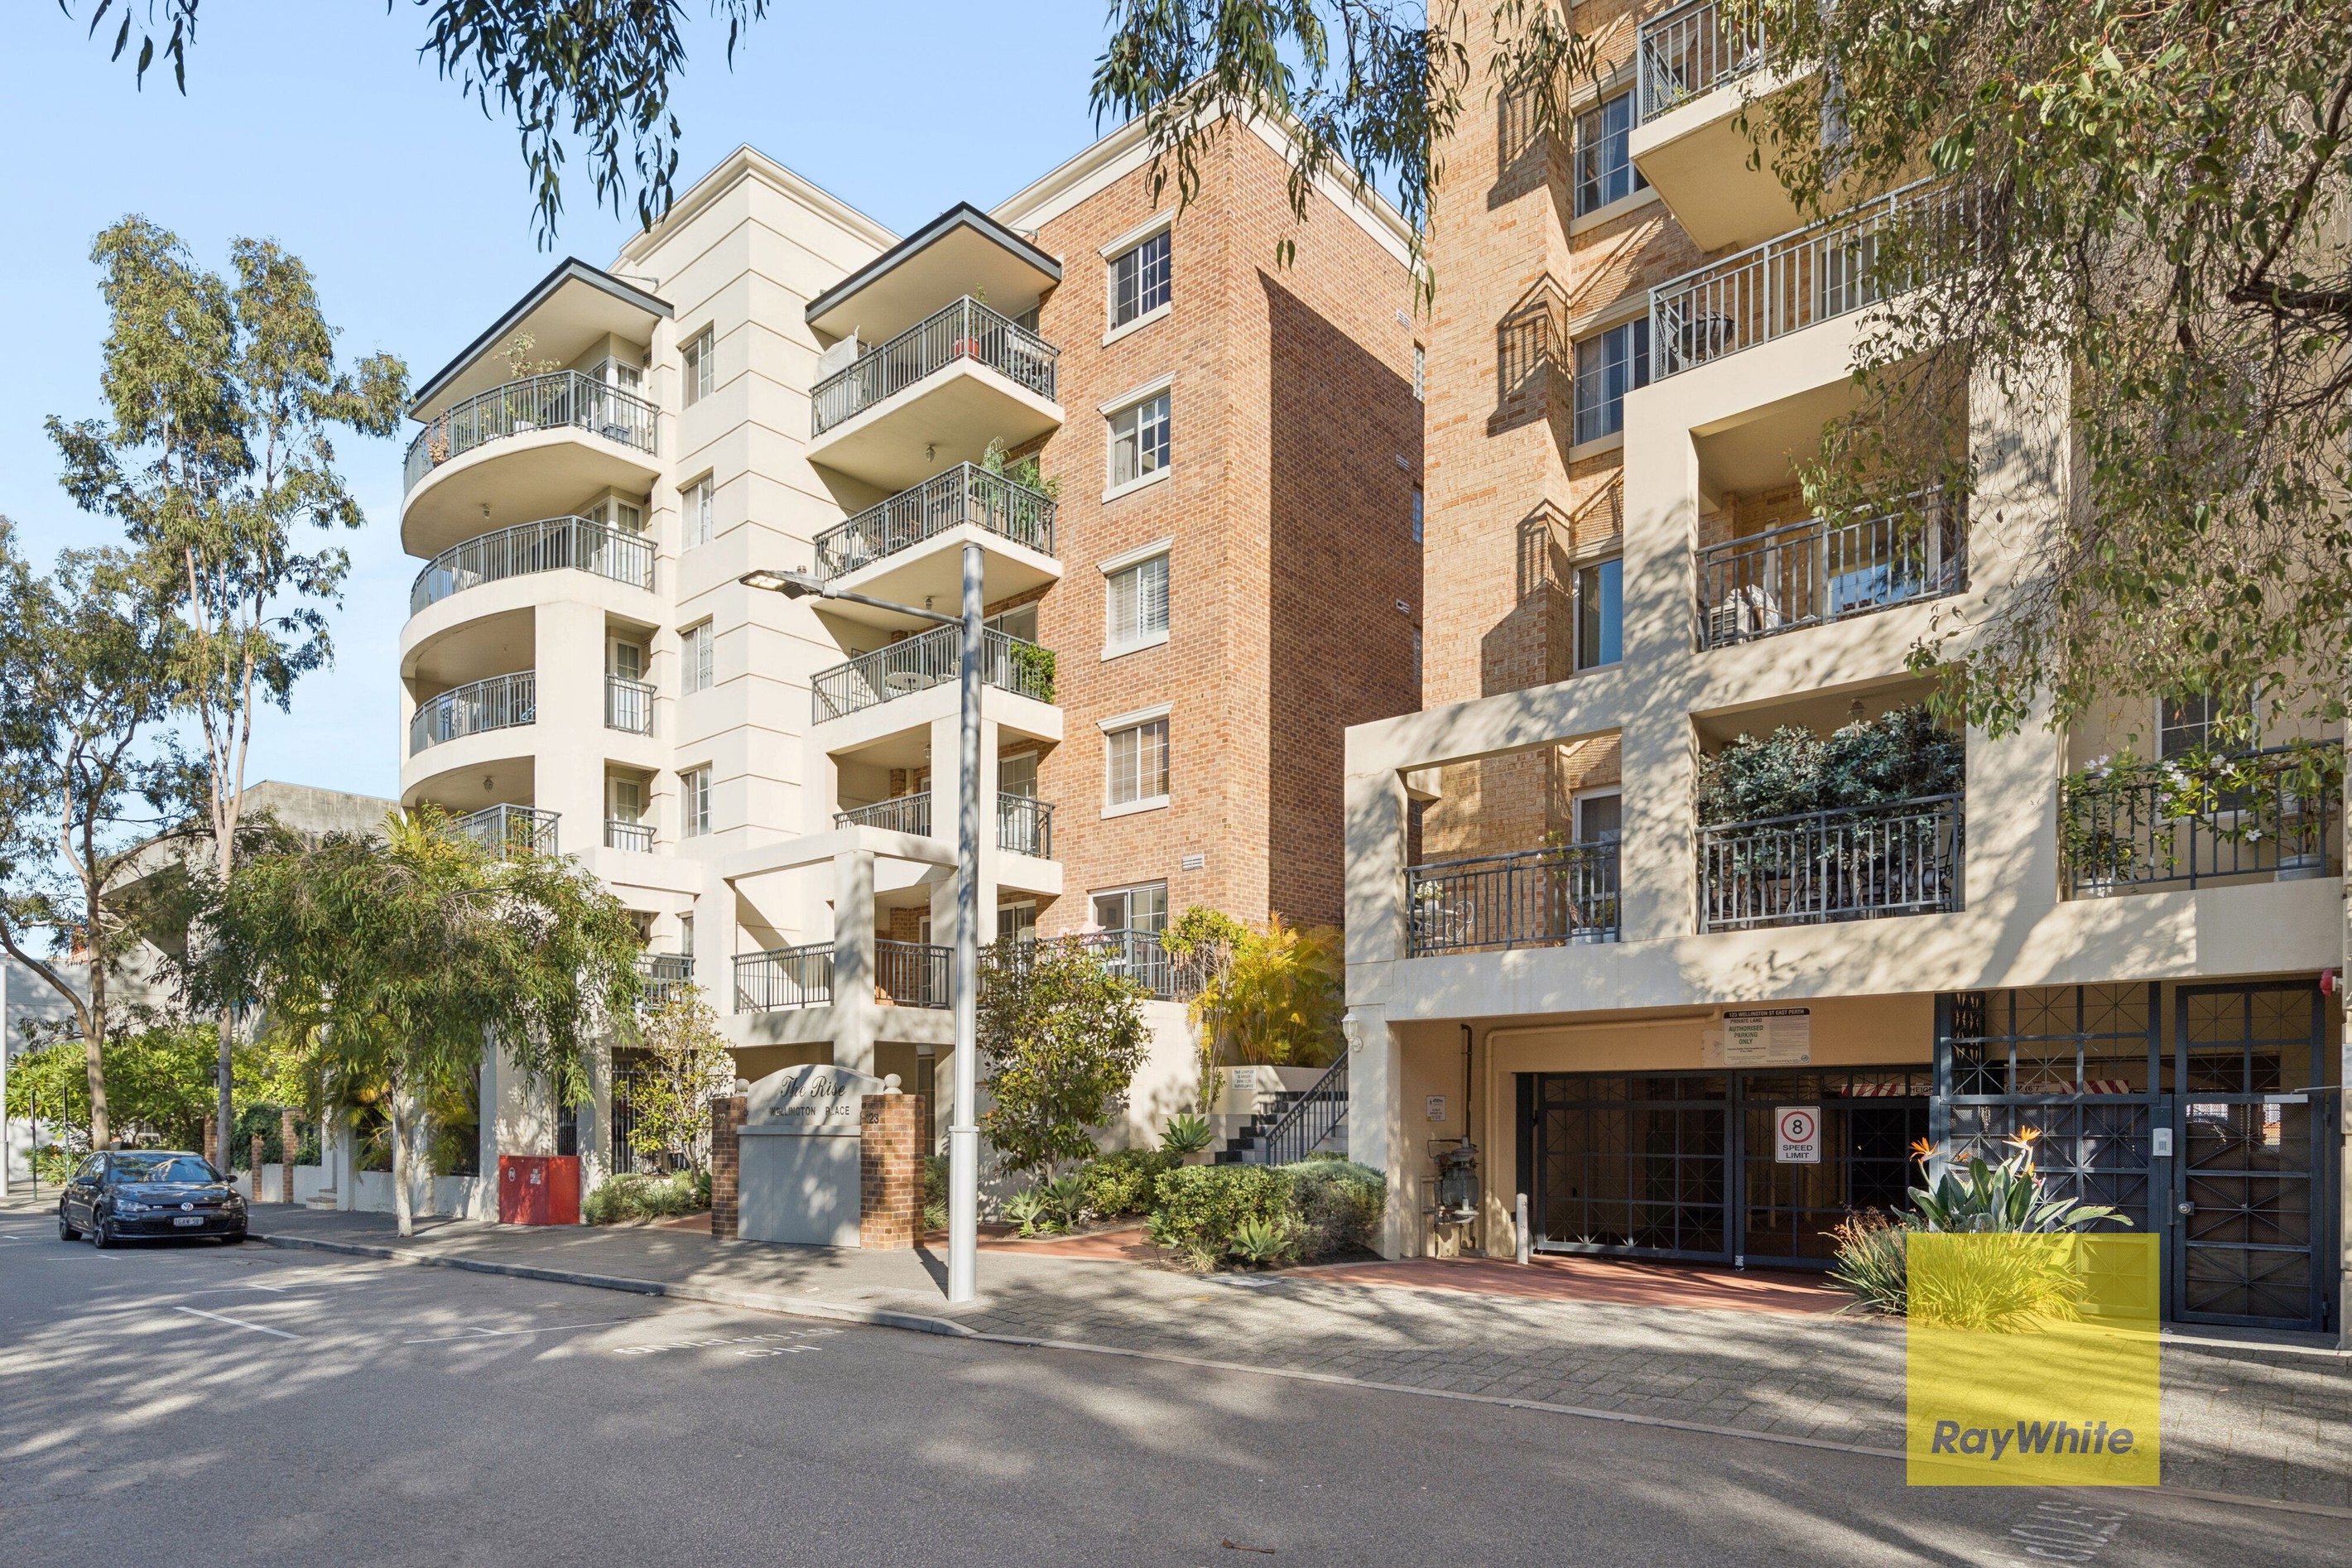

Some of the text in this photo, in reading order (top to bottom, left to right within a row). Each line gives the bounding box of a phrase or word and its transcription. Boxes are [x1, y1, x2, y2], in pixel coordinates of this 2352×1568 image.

[781, 1075, 846, 1098] The Rise
[769, 1106, 816, 1116] WELLINGTON
[1792, 1119, 1803, 1135] 8
